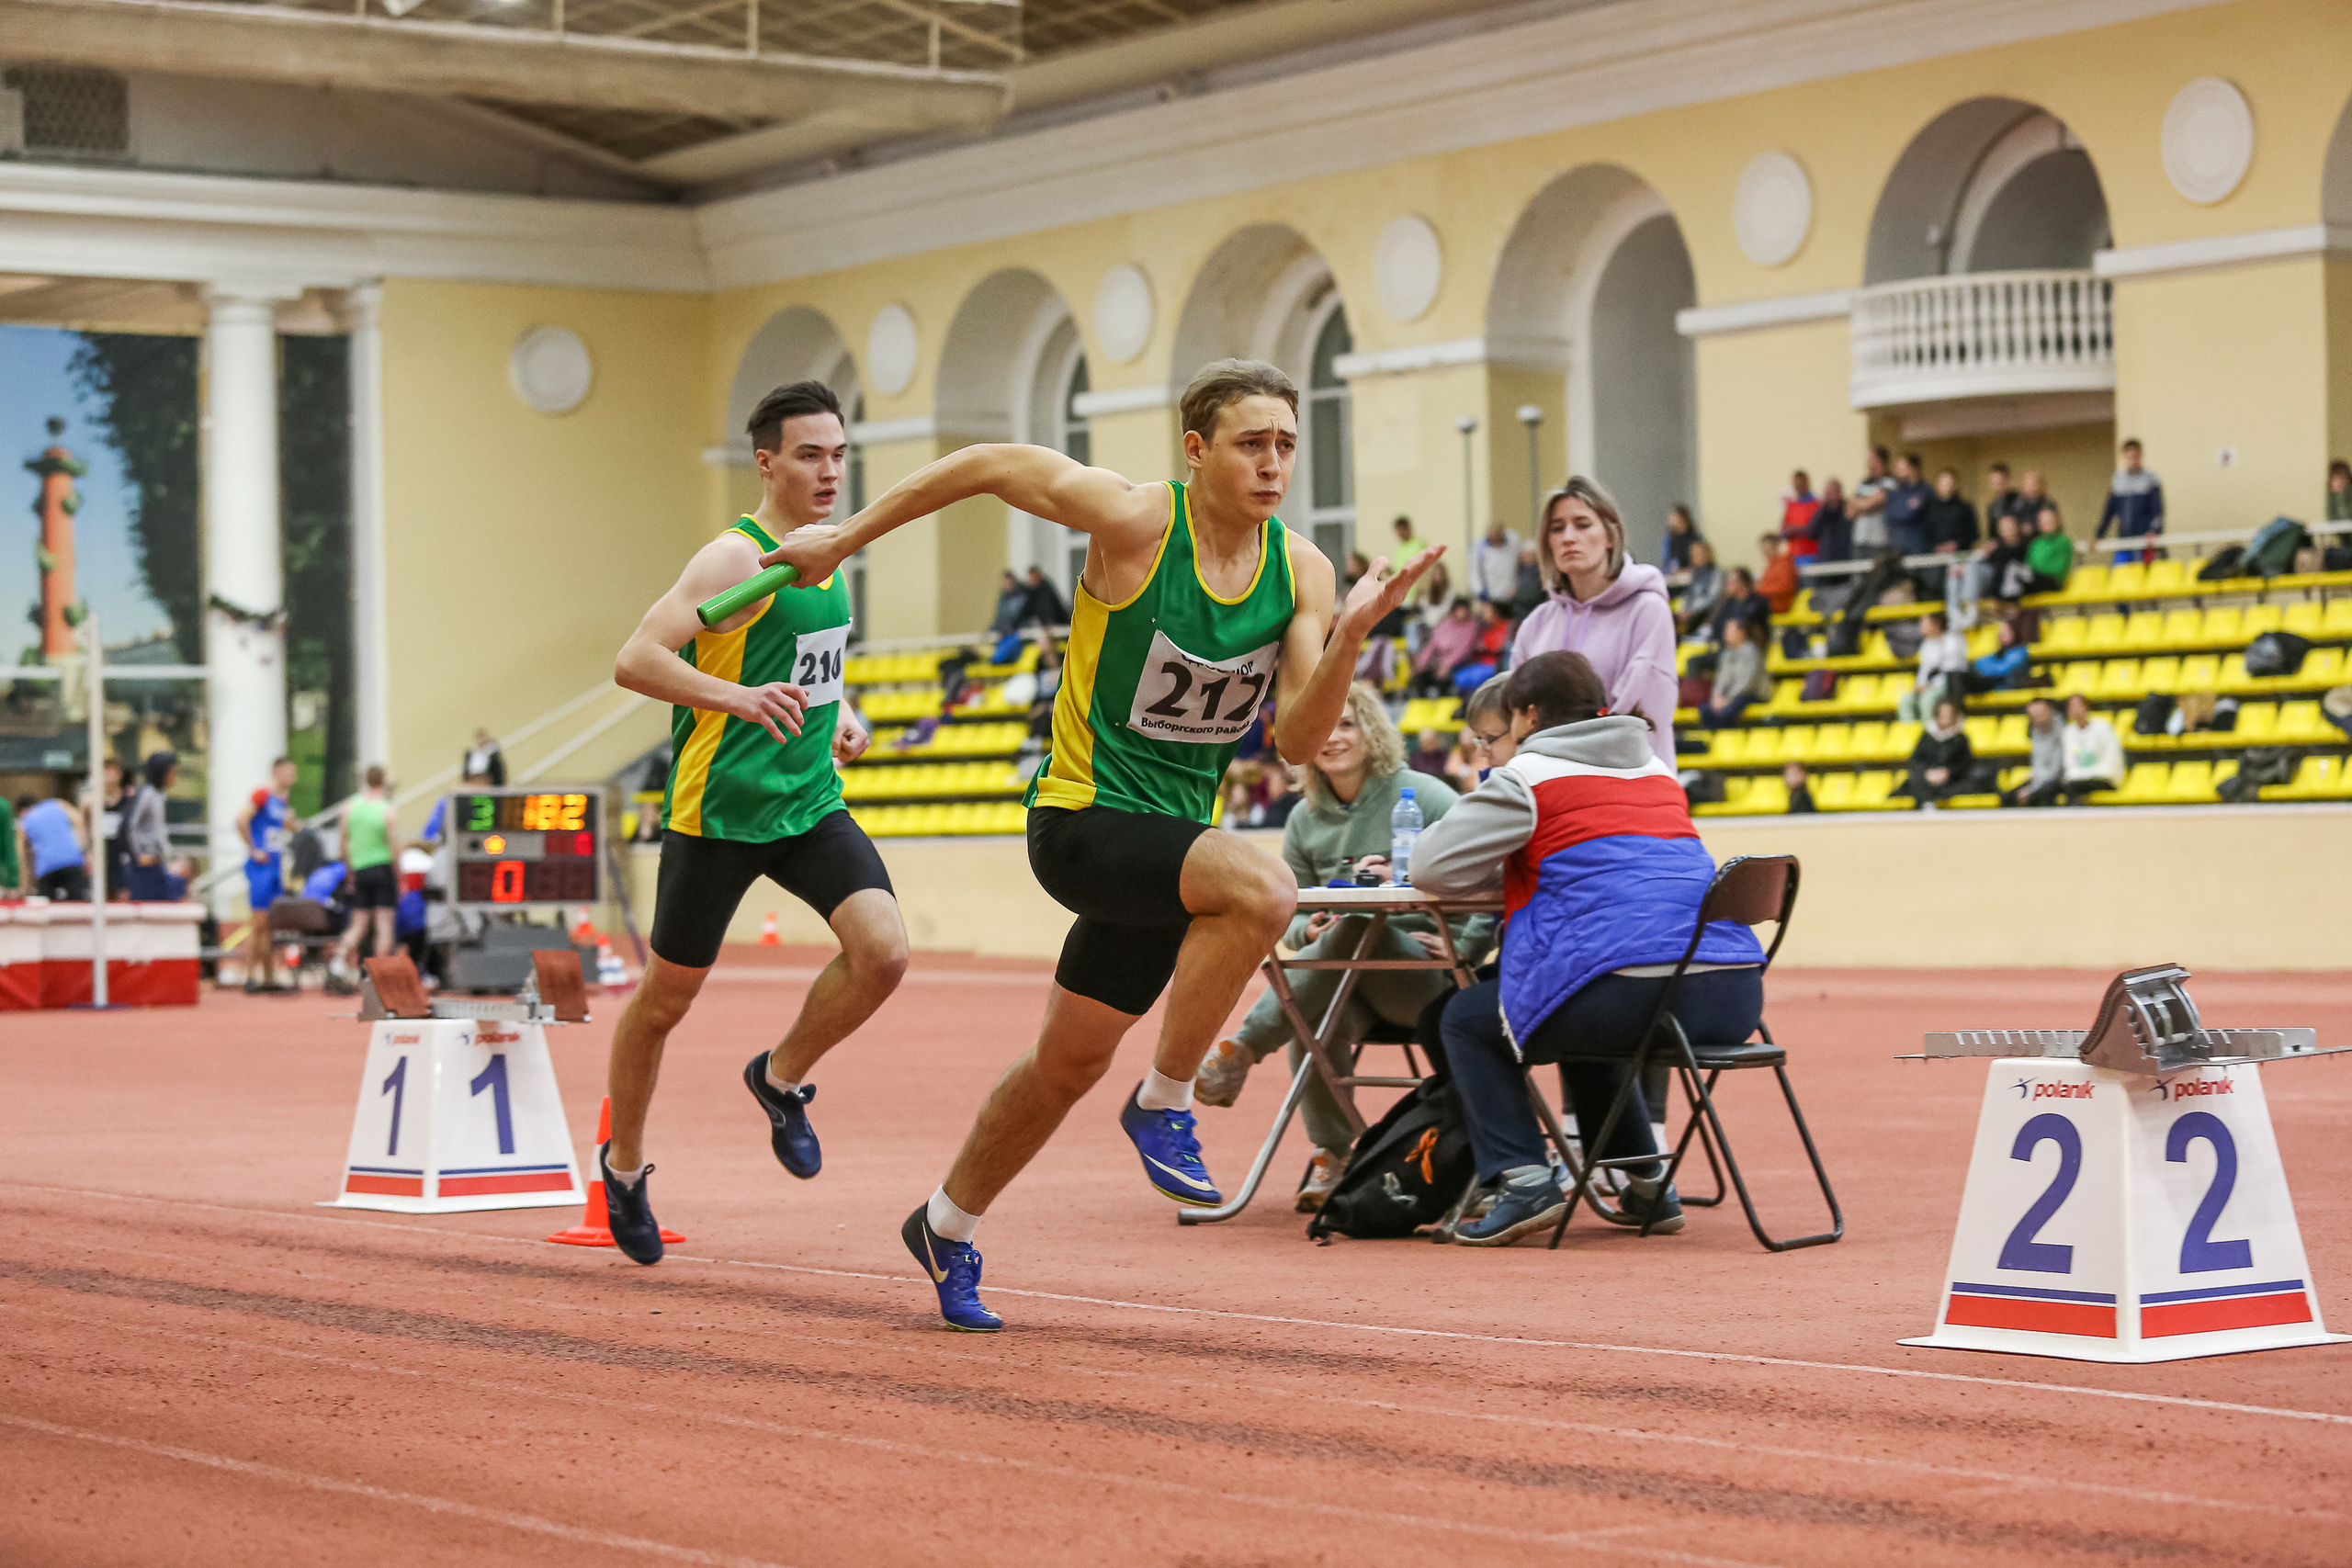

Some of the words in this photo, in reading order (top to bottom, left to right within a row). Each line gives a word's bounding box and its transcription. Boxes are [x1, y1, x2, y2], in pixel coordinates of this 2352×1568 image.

[1145, 660, 1266, 722] 212
[1141, 717, 1214, 733] Выборгского
[468, 794, 495, 831] 3
[492, 861, 525, 903] 0
[382, 1055, 408, 1156] 1
[470, 1054, 515, 1155] 1
[2032, 1079, 2096, 1101] polanik
[2174, 1076, 2234, 1102] polanik
[1996, 1113, 2082, 1275] 2
[2165, 1111, 2254, 1274] 2
